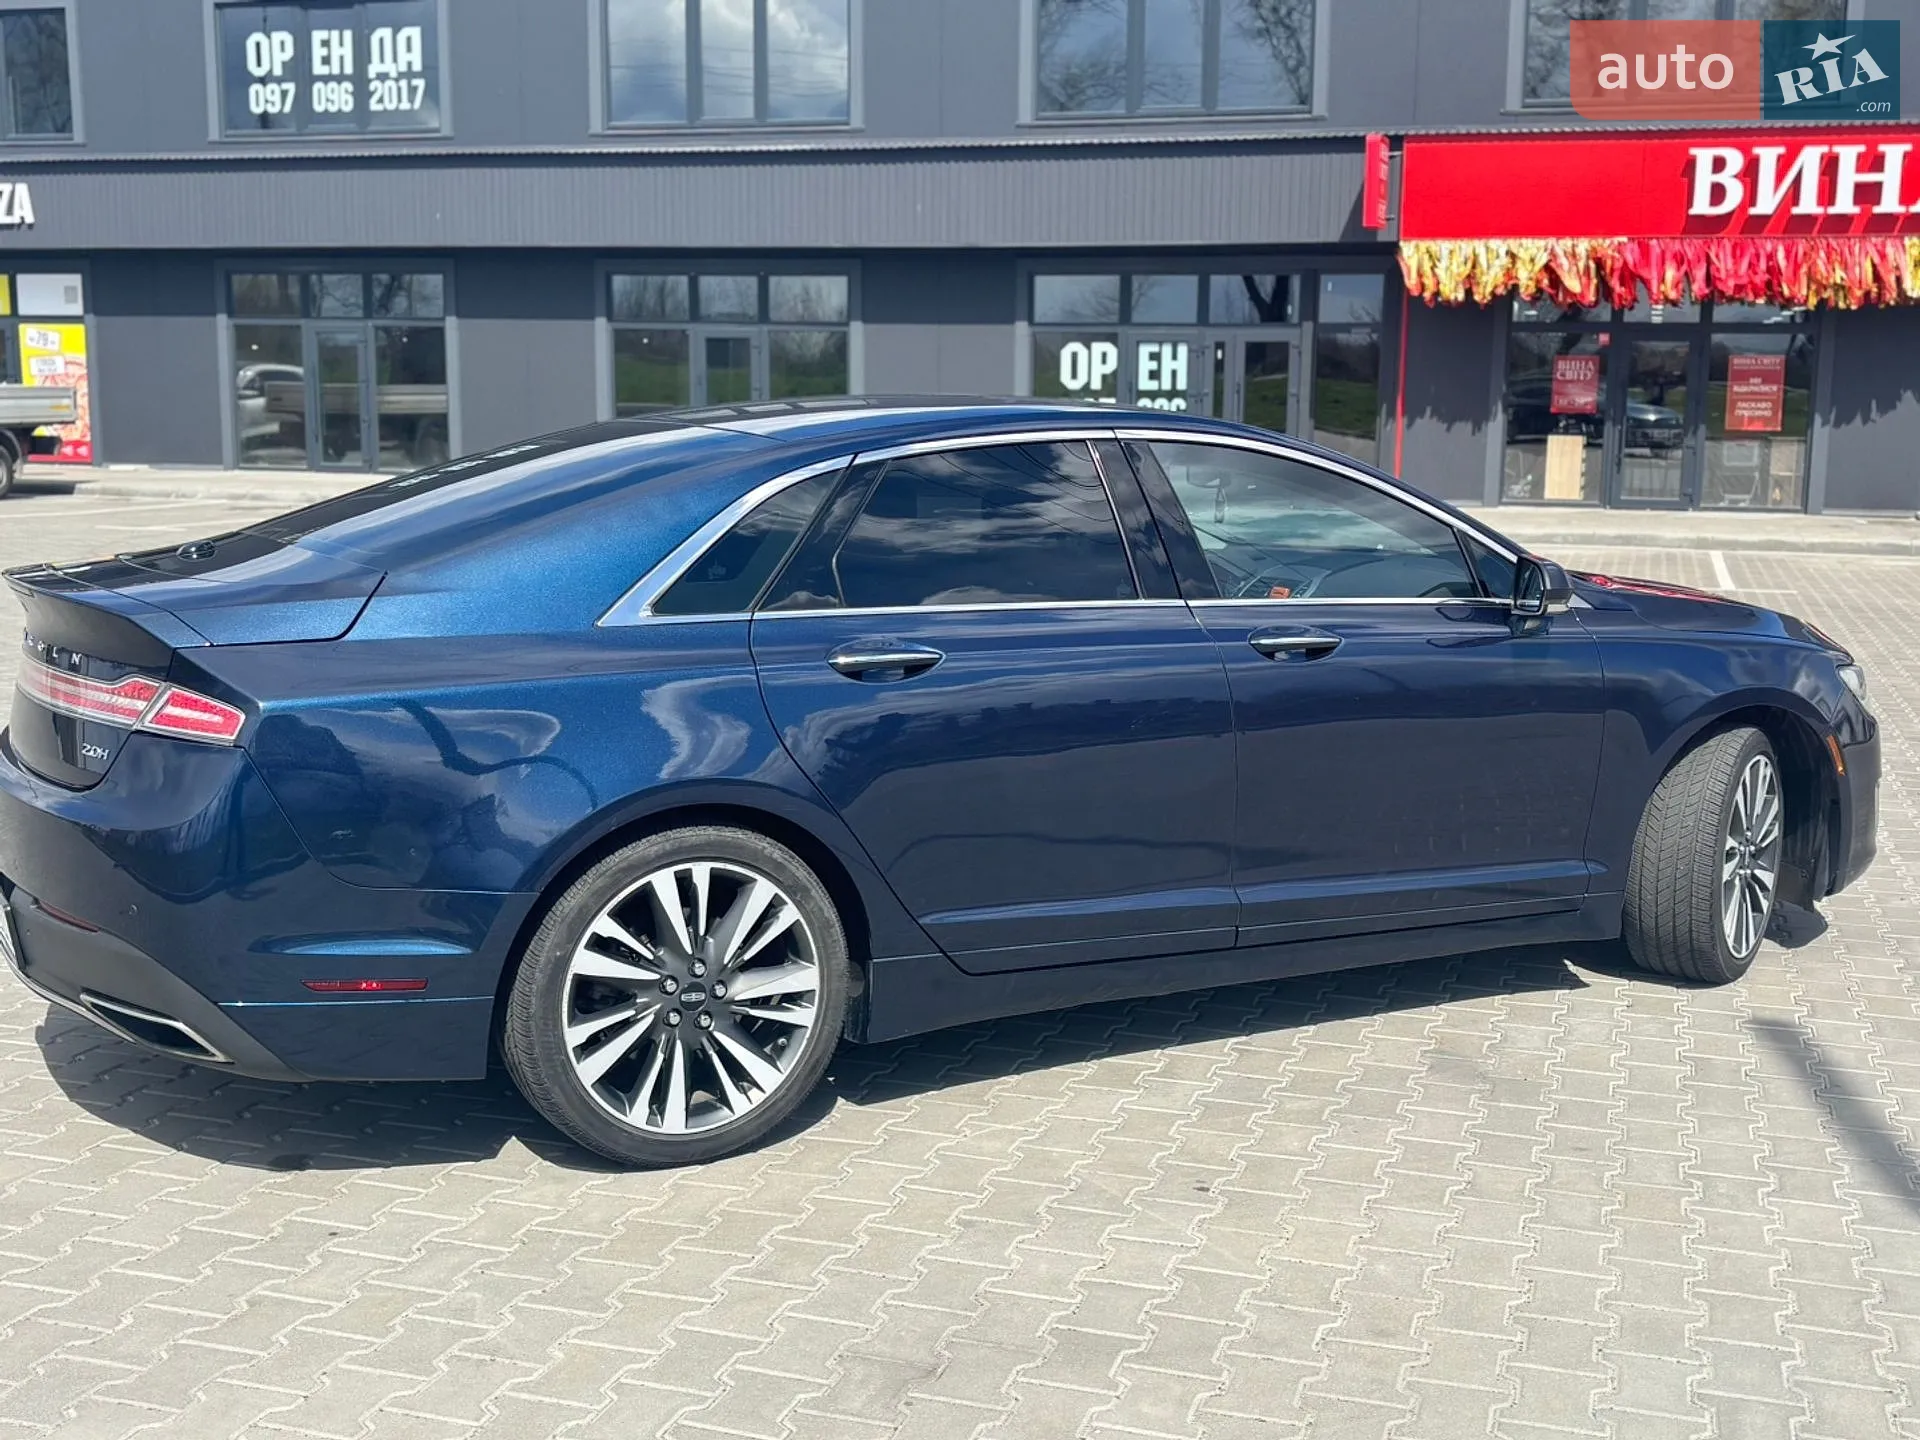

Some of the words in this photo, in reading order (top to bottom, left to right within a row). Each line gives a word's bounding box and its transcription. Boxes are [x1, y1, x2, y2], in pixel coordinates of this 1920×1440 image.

[249, 82, 295, 114] 097
[312, 81, 354, 113] 096
[369, 78, 425, 111] 2017
[1688, 143, 1920, 216] ВИН
[1060, 341, 1118, 390] ОР
[1138, 342, 1188, 391] ЕН
